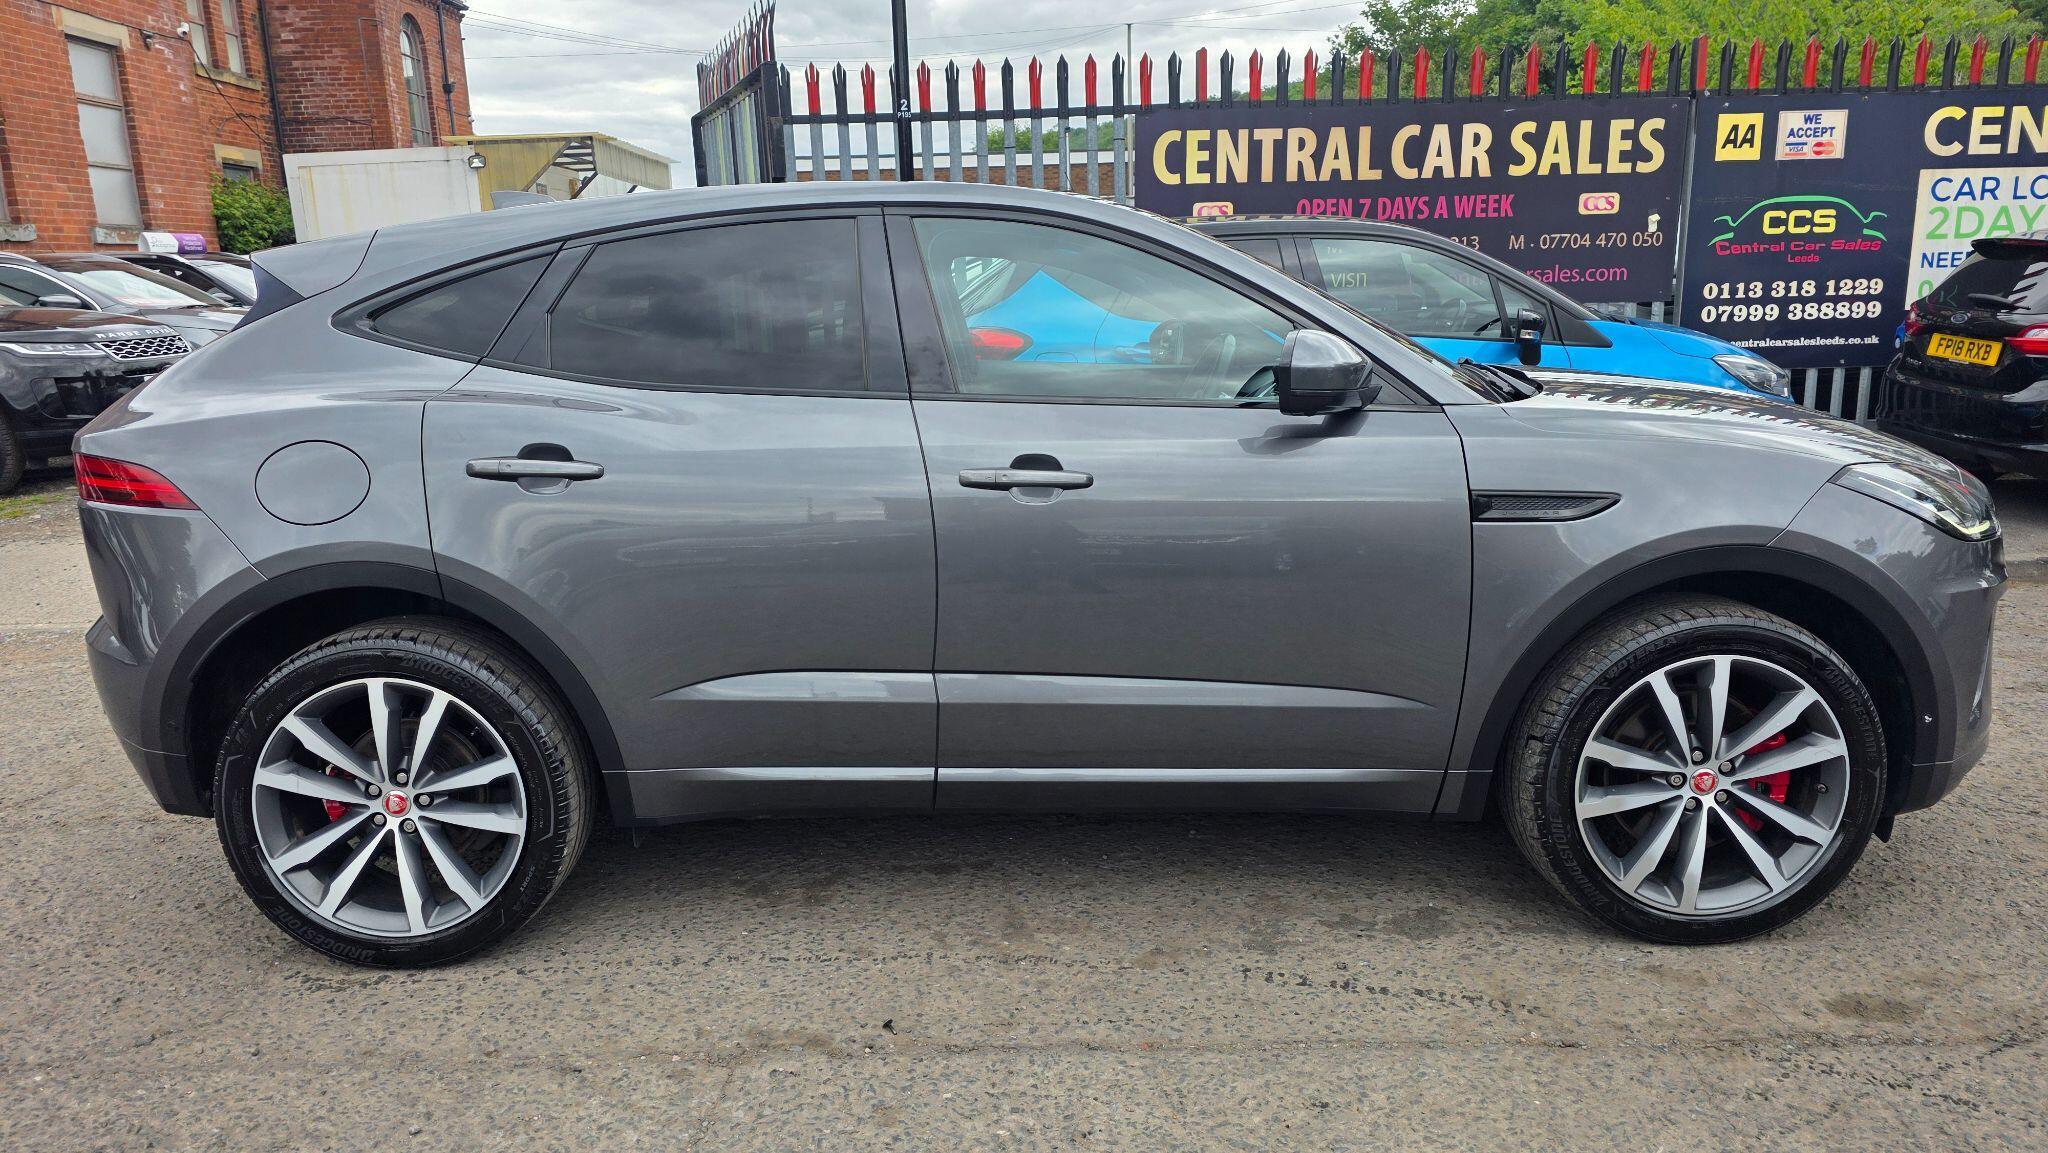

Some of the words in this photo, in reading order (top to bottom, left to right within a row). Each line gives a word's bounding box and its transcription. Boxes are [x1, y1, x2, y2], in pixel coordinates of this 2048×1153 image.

[900, 99, 908, 111] 2
[1803, 113, 1823, 125] WE
[1721, 123, 1757, 149] AA
[1786, 126, 1836, 139] ACCEPT
[1924, 105, 2048, 157] CEN
[1152, 126, 1383, 185] CENTRAL
[1390, 122, 1493, 180] CAR
[1507, 117, 1666, 177] SALES
[1930, 176, 2001, 202] CAR
[1296, 198, 1353, 217] OPEN
[1359, 198, 1372, 220] 7
[1377, 196, 1430, 221] DAYS
[1434, 195, 1449, 220] A
[1454, 193, 1516, 219] WEEK
[1762, 208, 1837, 235] CCS
[1539, 233, 1590, 250] 07704
[1596, 232, 1627, 249] 470
[1632, 231, 1663, 248] 050
[1716, 240, 1785, 256] Central
[1790, 241, 1826, 251] Car
[1830, 238, 1882, 251] Sales
[1787, 253, 1820, 263] Leeds
[1702, 280, 1764, 300] 0113
[1770, 279, 1817, 298] 318
[1825, 277, 1885, 297] 1229
[1700, 303, 1780, 323] 07999
[1787, 300, 1883, 321] 388899
[1935, 337, 1965, 356] FP18
[1964, 341, 1993, 362] RXB
